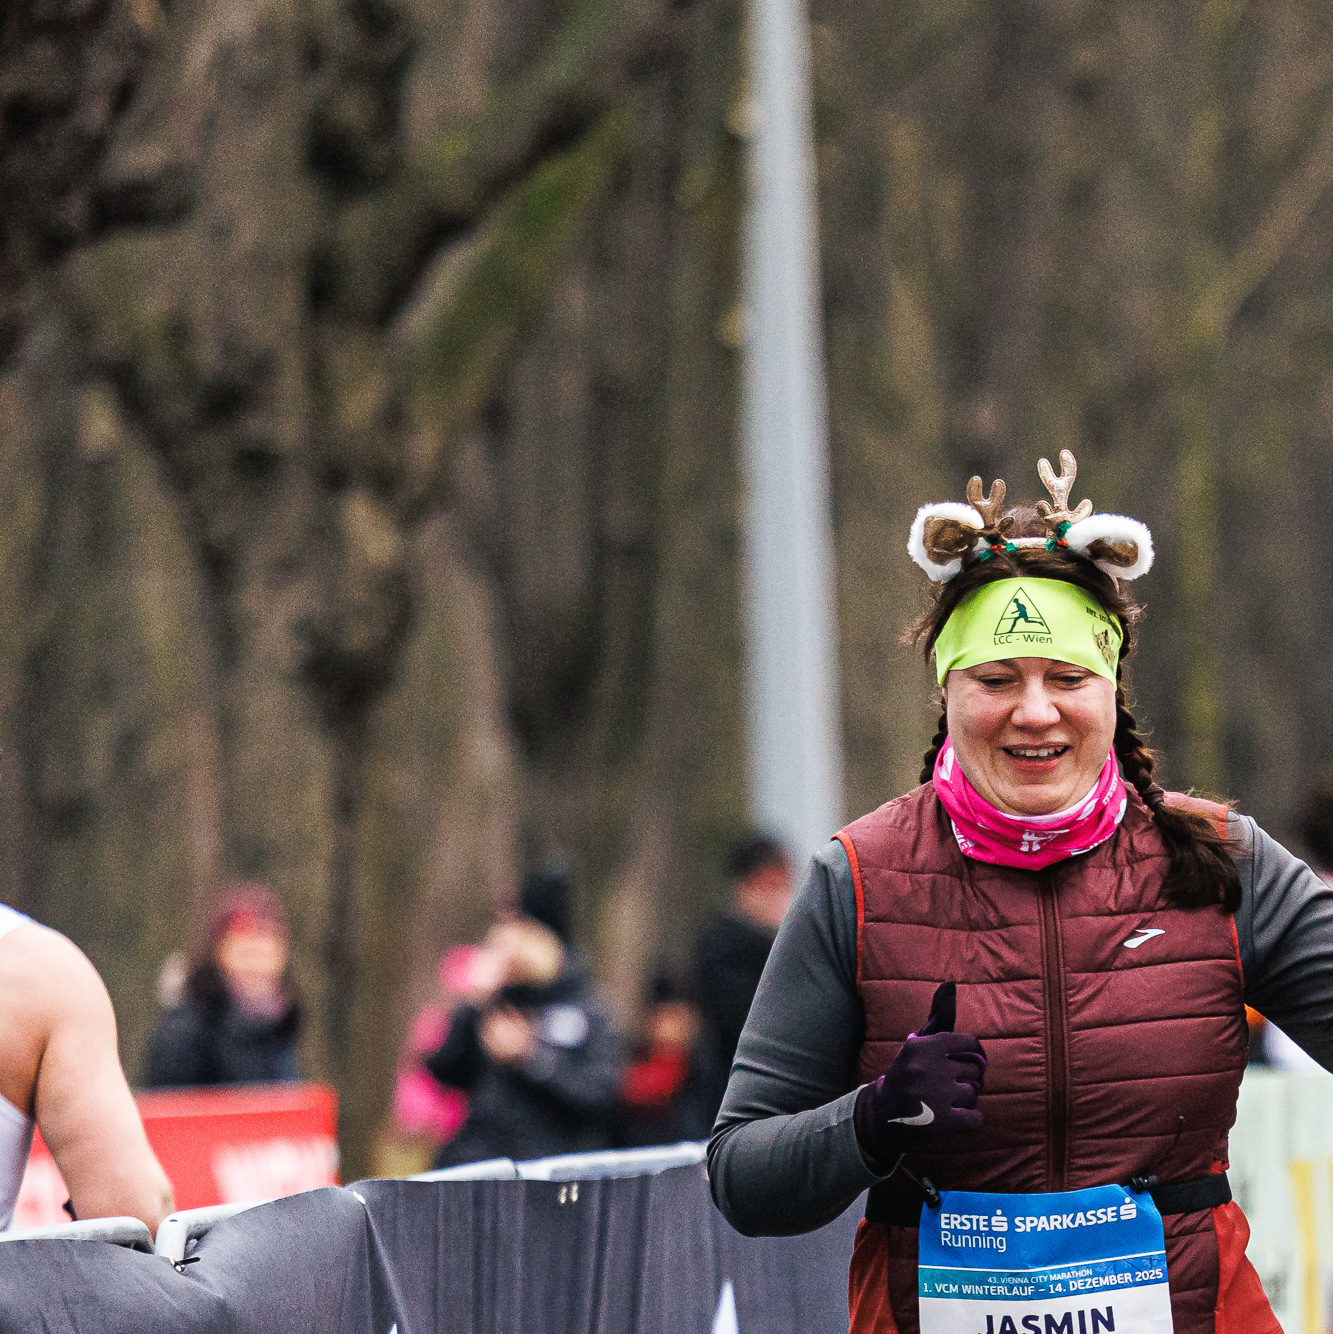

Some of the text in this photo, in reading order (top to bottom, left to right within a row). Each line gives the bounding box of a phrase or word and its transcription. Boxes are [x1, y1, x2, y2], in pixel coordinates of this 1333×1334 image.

[993, 634, 1013, 645] LCC
[1022, 634, 1053, 644] Wien
[940, 1206, 1118, 1232] ERSTE SPARKASSE
[940, 1230, 1007, 1253] Running
[923, 1283, 932, 1293] 1.
[935, 1283, 959, 1294] VCM
[961, 1284, 1035, 1296] WINTERLAUF
[1049, 1283, 1067, 1294] 14.
[1069, 1272, 1133, 1291] DEZEMBER
[1135, 1268, 1163, 1282] 2025
[987, 1269, 1093, 1284] 43. VIENNA CITY MARATHON
